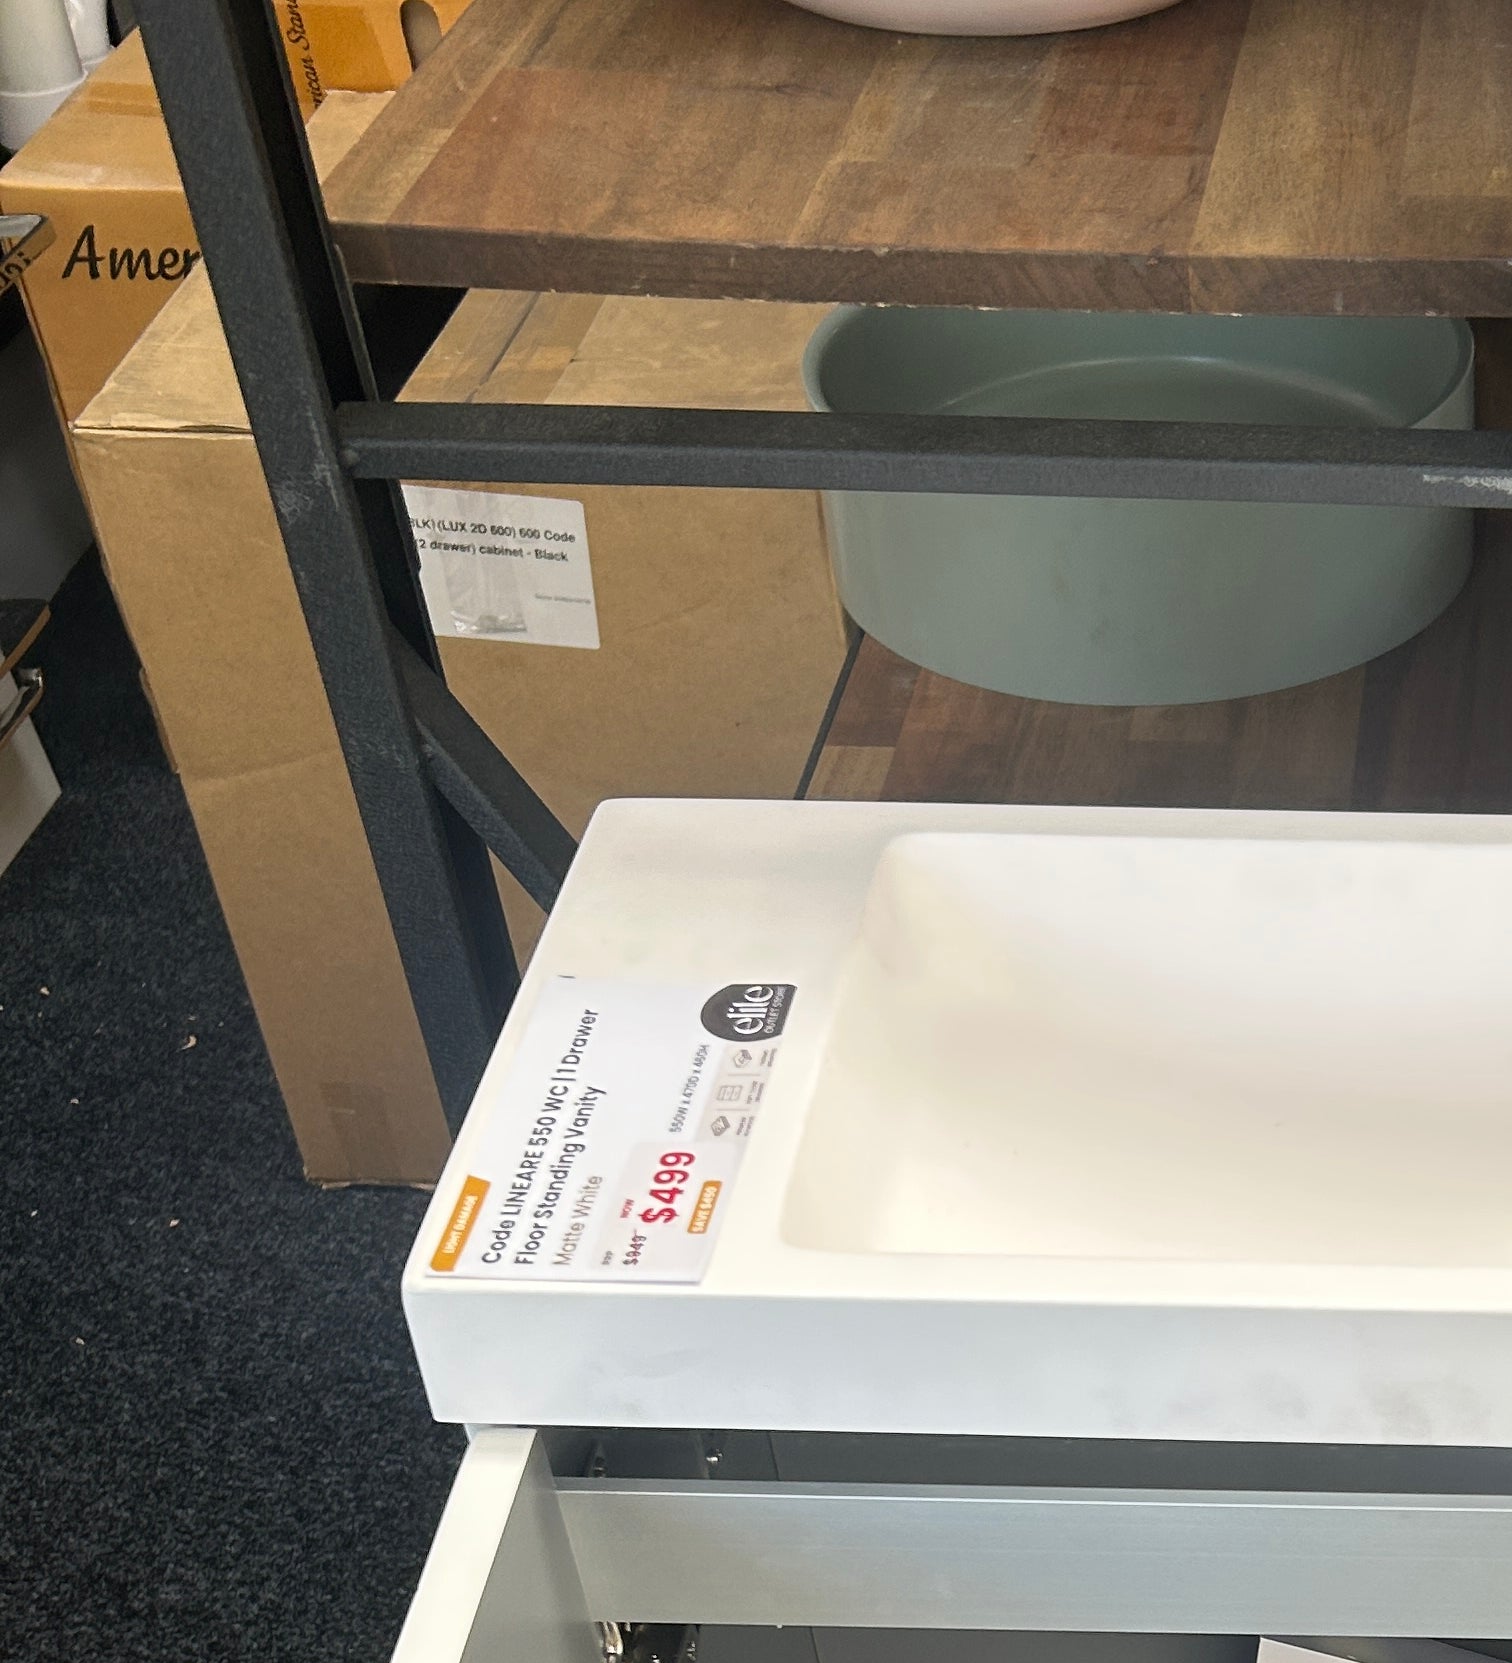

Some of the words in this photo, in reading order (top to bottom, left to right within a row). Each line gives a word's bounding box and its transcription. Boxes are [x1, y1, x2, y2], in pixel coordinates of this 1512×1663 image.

[286, 0, 309, 51] Stan
[300, 55, 322, 109] rican
[62, 225, 200, 280] Amer
[430, 541, 476, 555] drawer)
[479, 545, 524, 558] cabinet
[535, 548, 569, 562] Black
[470, 522, 487, 534] 2D
[490, 526, 516, 539] 600)
[519, 528, 540, 540] 600
[543, 530, 576, 543] Code
[727, 986, 774, 1035] elite
[561, 1009, 599, 1065] Drawer
[542, 1085, 569, 1113] WC
[528, 1116, 557, 1147] 550
[500, 1150, 544, 1215] LINEARE
[514, 1221, 548, 1265] Floor
[533, 1143, 586, 1219] Standing
[563, 1086, 607, 1139] Vanity
[638, 1152, 696, 1224] $499
[552, 1221, 586, 1266] Matte
[571, 1175, 603, 1219] White
[620, 1198, 635, 1219] NOW
[692, 1209, 709, 1233] SAVE
[481, 1220, 516, 1264] Code
